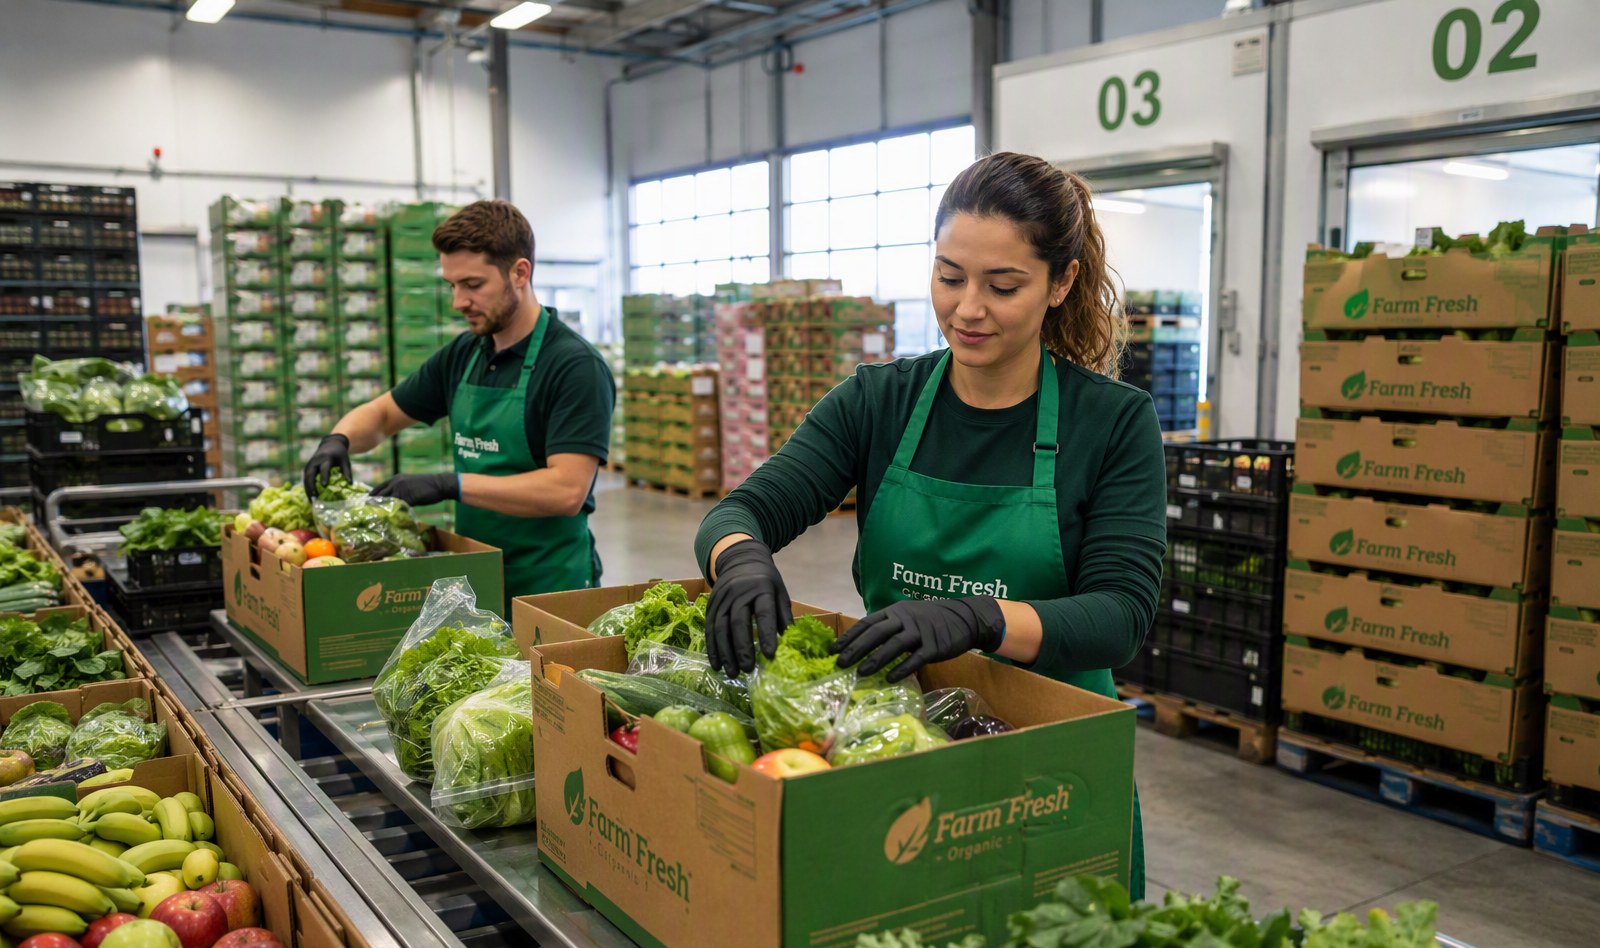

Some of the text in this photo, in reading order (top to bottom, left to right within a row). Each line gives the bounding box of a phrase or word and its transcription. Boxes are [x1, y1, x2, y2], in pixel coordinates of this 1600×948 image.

[1431, 0, 1541, 81] 02
[1097, 69, 1162, 131] 03
[1372, 294, 1478, 314] Farm Fresh
[1368, 380, 1472, 399] Farm Fresh
[1363, 460, 1466, 484] Farm Fresh
[1356, 538, 1457, 567] Farm Fresh
[384, 590, 421, 604] Farm
[892, 562, 943, 591] Farm
[948, 575, 1008, 599] Fresh
[1350, 616, 1449, 649] Farm Fresh
[1347, 694, 1445, 731] Farm Fresh
[934, 784, 1070, 844] Farm Fresh
[588, 796, 632, 858] Farm
[636, 832, 690, 903] Fresh
[947, 834, 1003, 862] Organic
